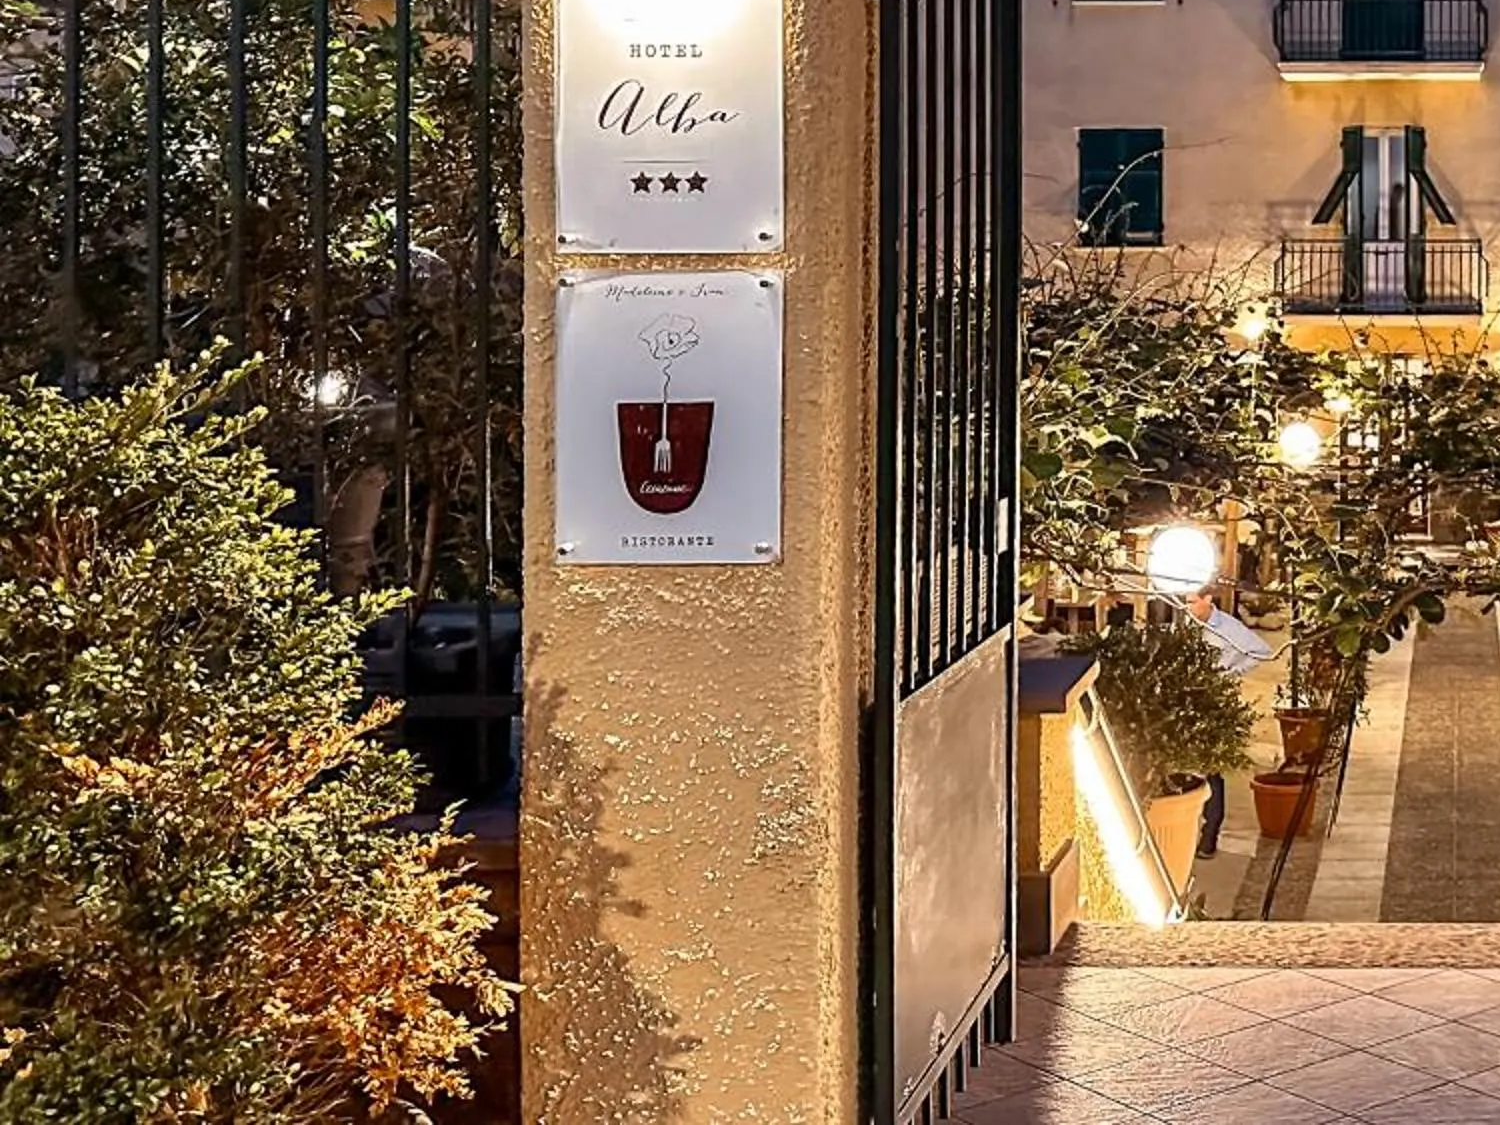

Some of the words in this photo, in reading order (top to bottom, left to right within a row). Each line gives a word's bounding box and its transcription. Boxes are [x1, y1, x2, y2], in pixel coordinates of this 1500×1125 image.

[629, 43, 703, 59] HOTEL
[597, 78, 740, 136] Alba
[621, 536, 715, 548] RISTORANTE
